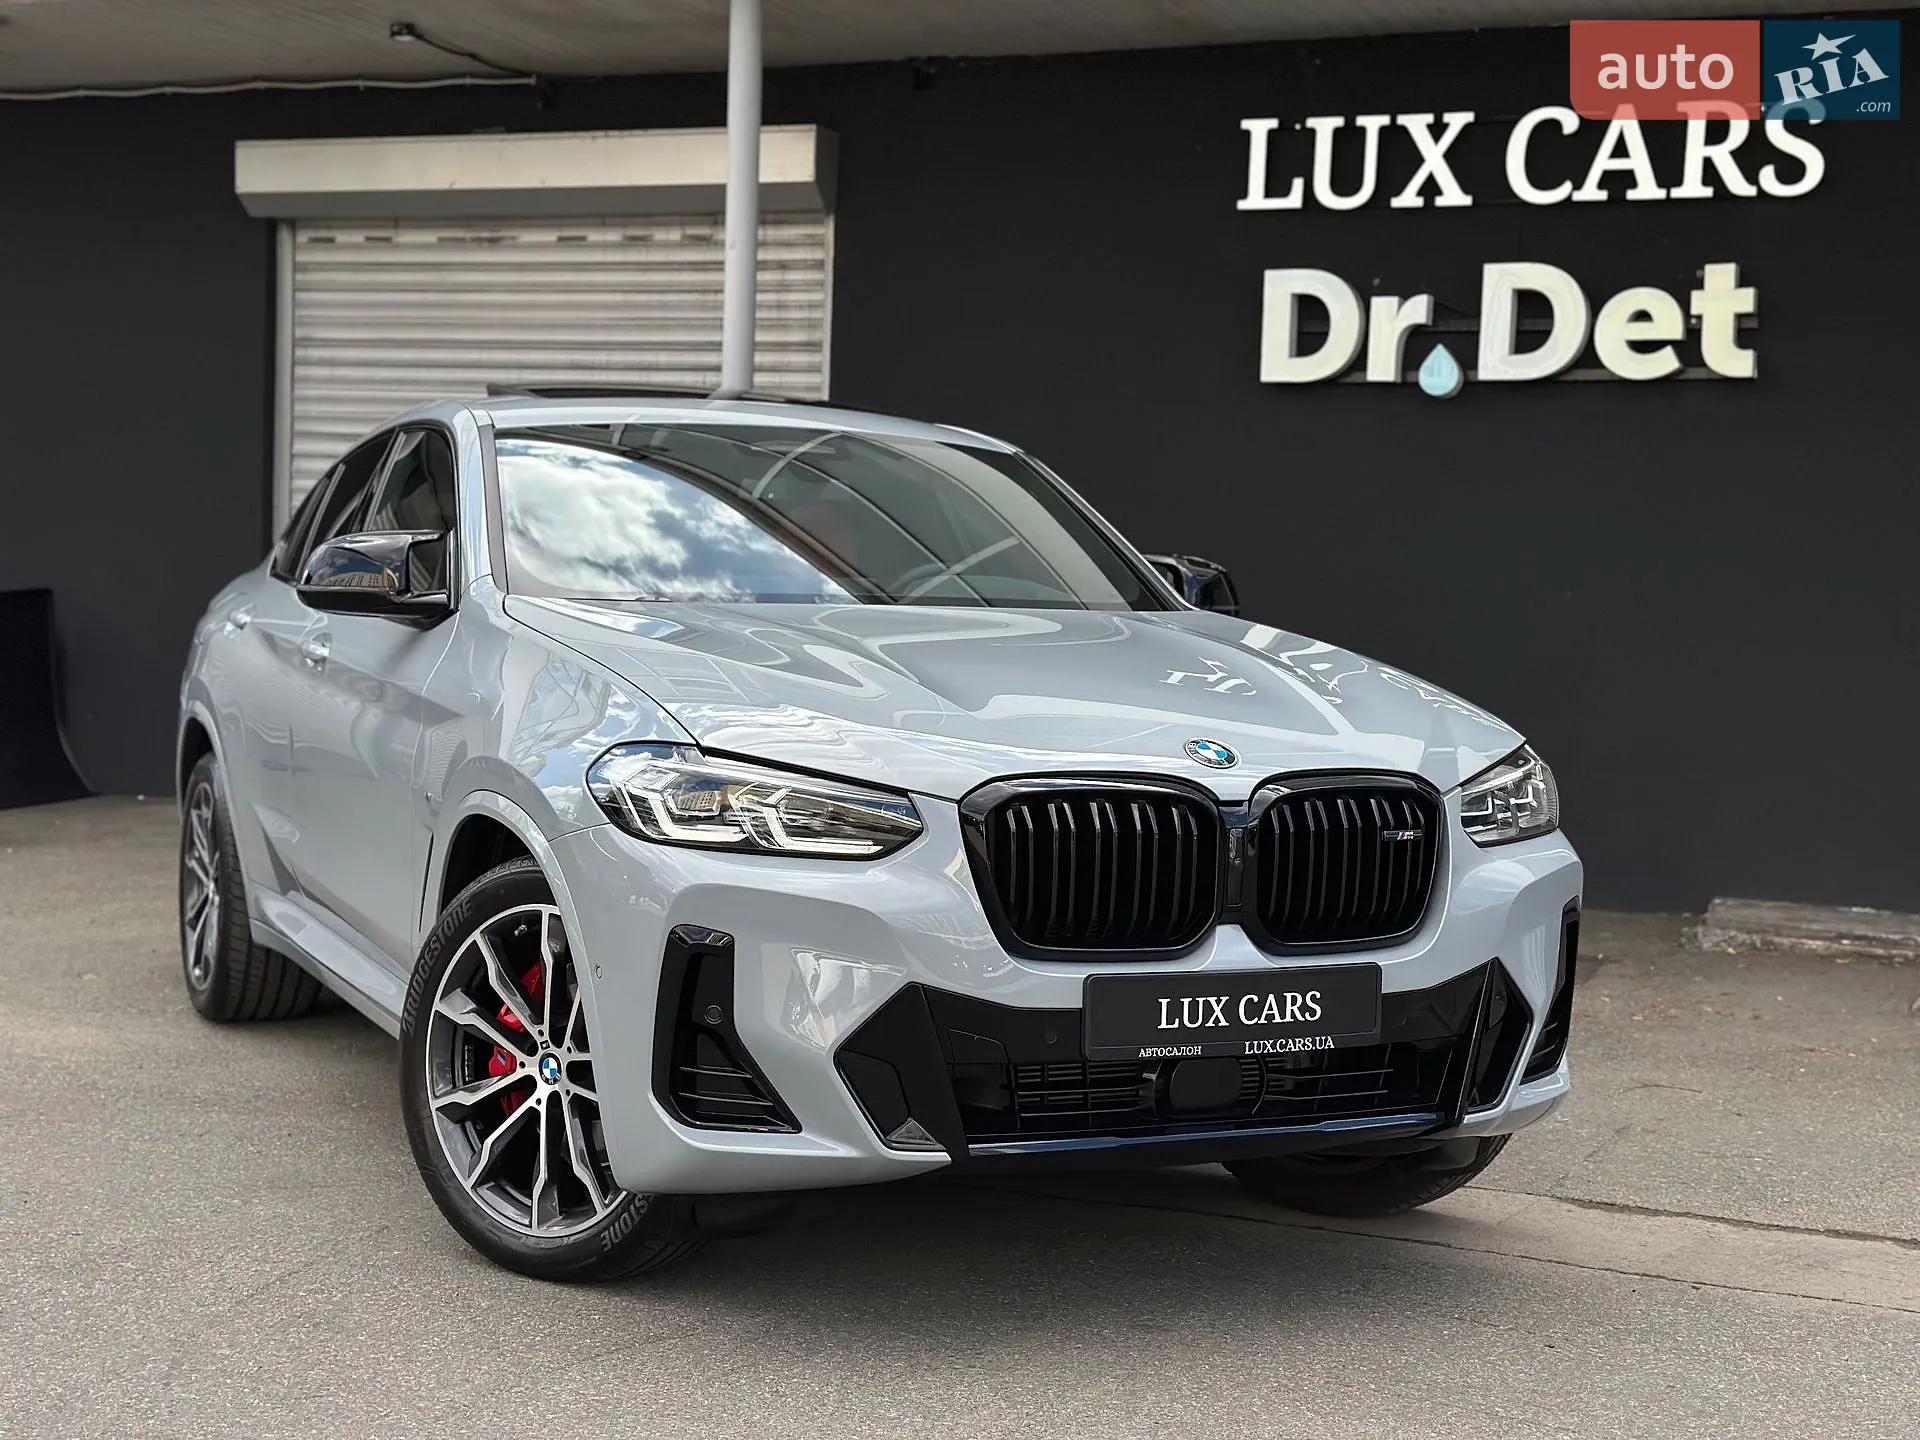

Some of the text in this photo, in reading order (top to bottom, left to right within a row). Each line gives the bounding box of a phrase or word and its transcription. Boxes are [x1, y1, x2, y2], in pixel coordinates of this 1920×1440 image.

[1237, 100, 1826, 211] LUX CARS
[1157, 990, 1323, 1030] LUX CARS
[1138, 1045, 1202, 1058] АВТОСАЛОН
[1244, 1036, 1335, 1055] LUX.CARS.UA
